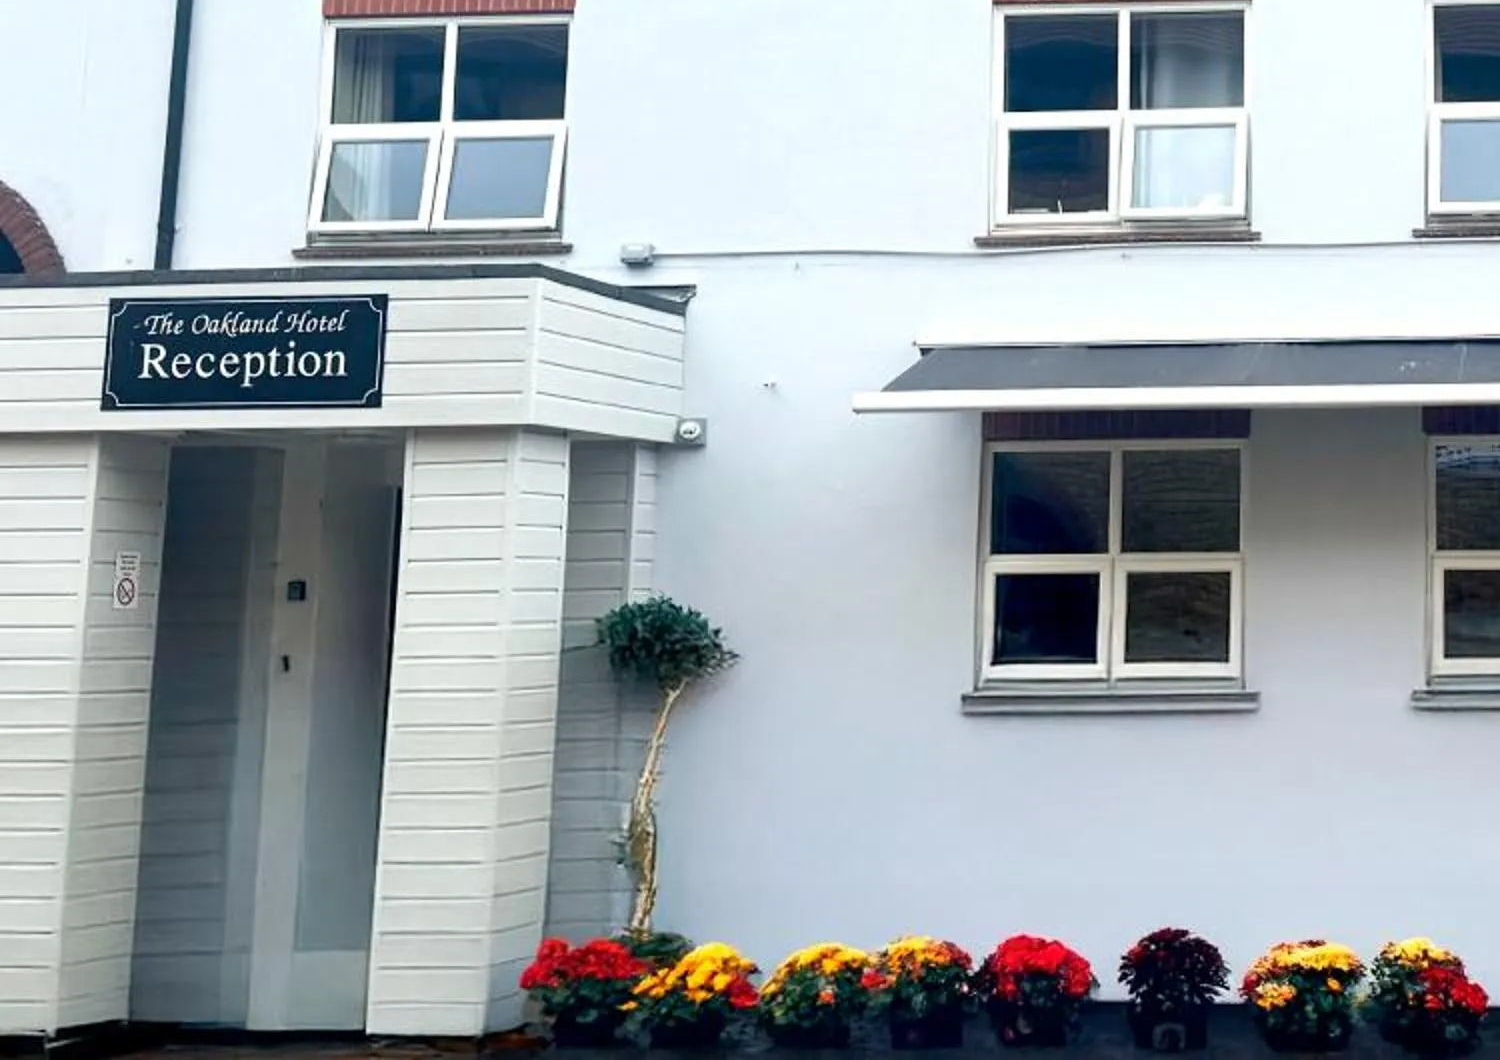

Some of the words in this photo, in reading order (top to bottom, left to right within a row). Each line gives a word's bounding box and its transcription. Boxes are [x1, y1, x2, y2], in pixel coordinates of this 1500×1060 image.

[144, 313, 183, 335] The
[191, 311, 282, 337] Oakland
[284, 310, 350, 333] Hotel
[137, 341, 348, 387] Reception
